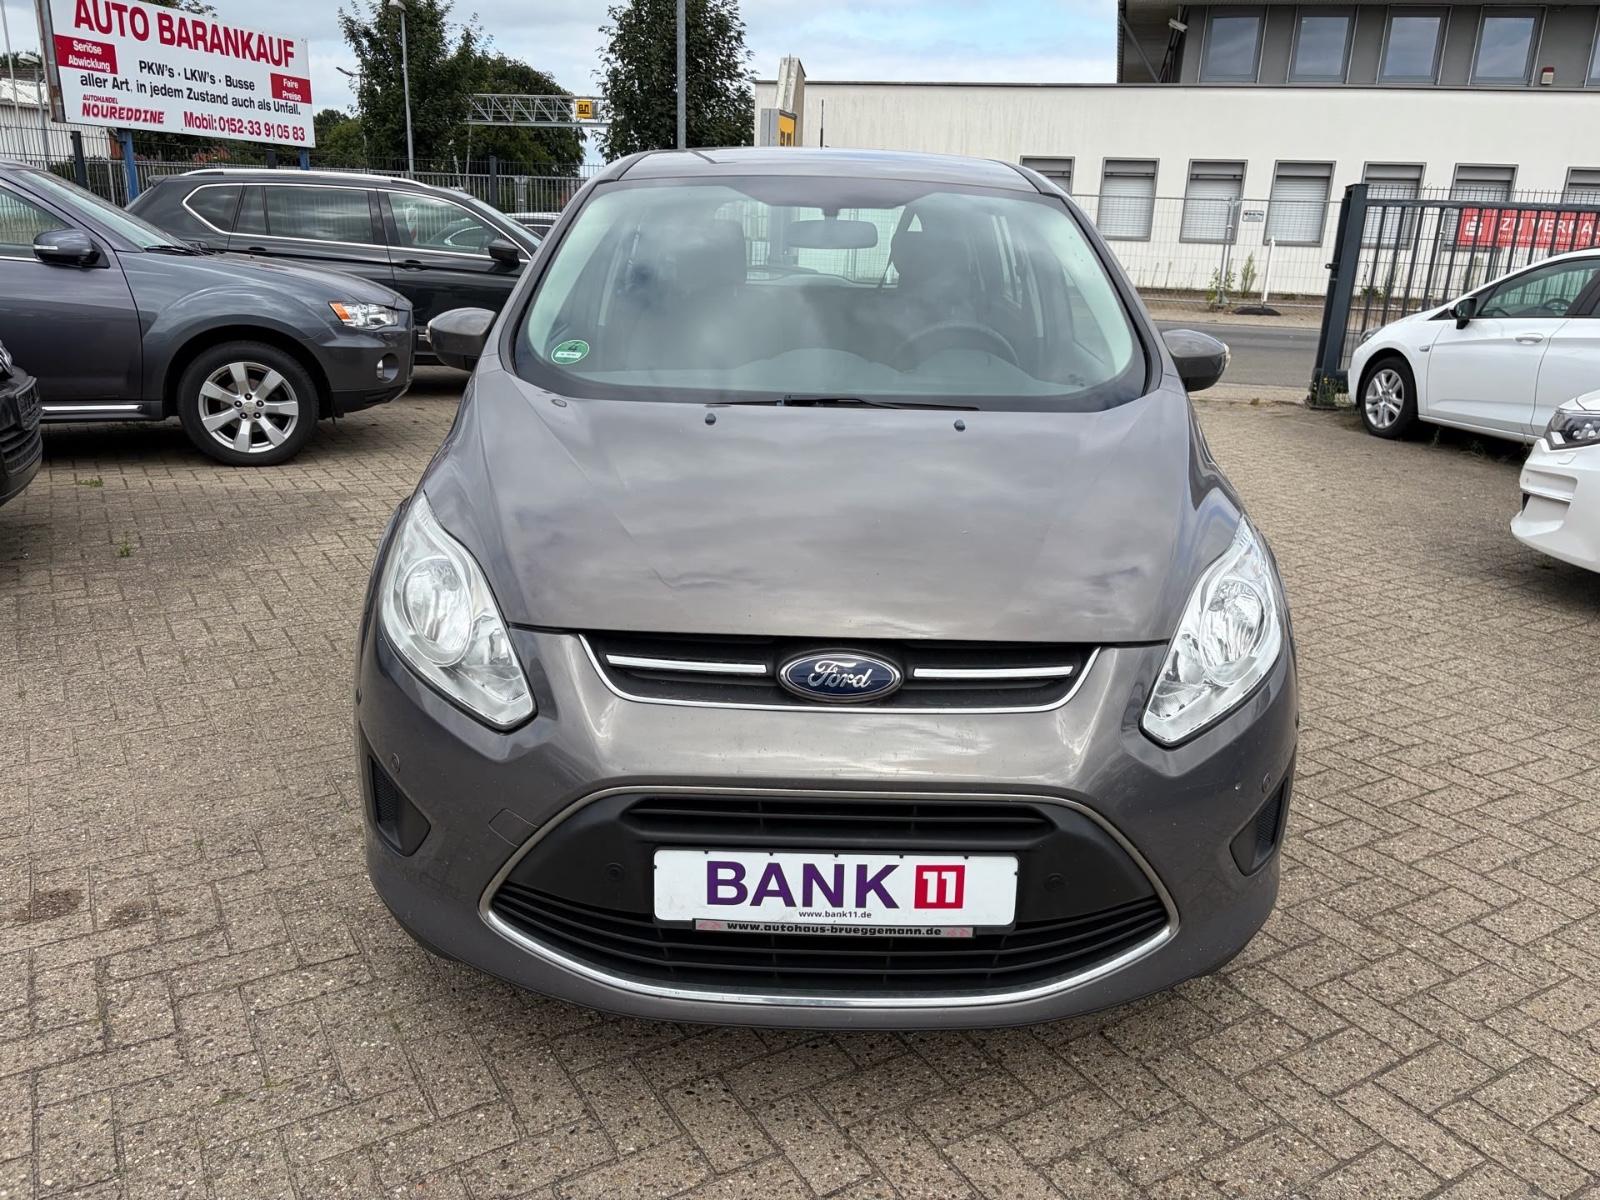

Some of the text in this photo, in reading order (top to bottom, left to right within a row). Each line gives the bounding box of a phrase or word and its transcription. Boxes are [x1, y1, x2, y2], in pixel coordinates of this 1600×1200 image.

[74, 0, 295, 68] AUTO BARANKAUF
[72, 39, 102, 55] Seriöse
[68, 54, 111, 72] Abwicklung
[138, 59, 255, 92] PKW's LKW's Busse
[282, 78, 299, 89] Faire
[80, 73, 108, 89] aller
[136, 80, 147, 94] in
[149, 81, 184, 98] jedem
[186, 87, 229, 105] Zustand
[231, 92, 256, 110] auch
[257, 97, 272, 112] als
[273, 100, 301, 116] Unfall.
[82, 93, 119, 105] AUTOHANDEL
[281, 90, 302, 102] Preise
[81, 102, 165, 124] NOUREDDINE
[292, 126, 305, 142] 83
[807, 660, 873, 689] Ford
[705, 860, 958, 910] BANK 11
[798, 909, 873, 919] www.bank11.de
[726, 920, 943, 938] www.autohaus-brueggemann.de
